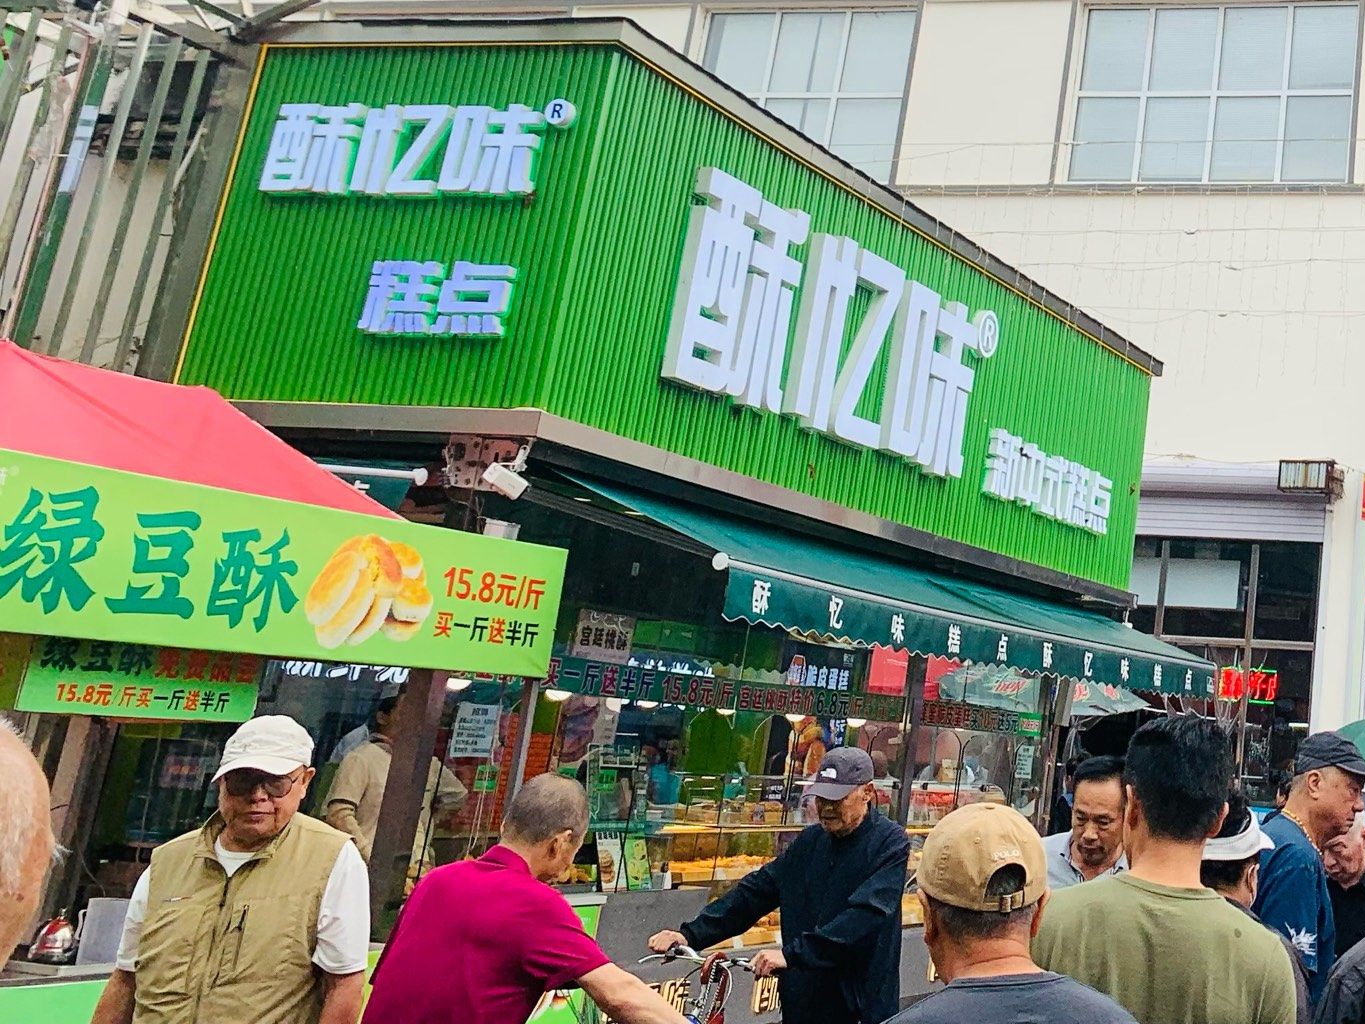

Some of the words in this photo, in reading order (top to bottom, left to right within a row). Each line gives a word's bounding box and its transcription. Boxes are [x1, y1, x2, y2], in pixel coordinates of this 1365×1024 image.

[259, 102, 543, 197] 酥忆味
[356, 260, 517, 338] 糕点
[662, 166, 980, 478] 酥忆味
[982, 427, 1112, 536] 新中式糕点
[0, 485, 300, 633] 绿豆酥
[443, 566, 546, 610] 15.8元/斤
[433, 611, 539, 648] 买一斤送半斤
